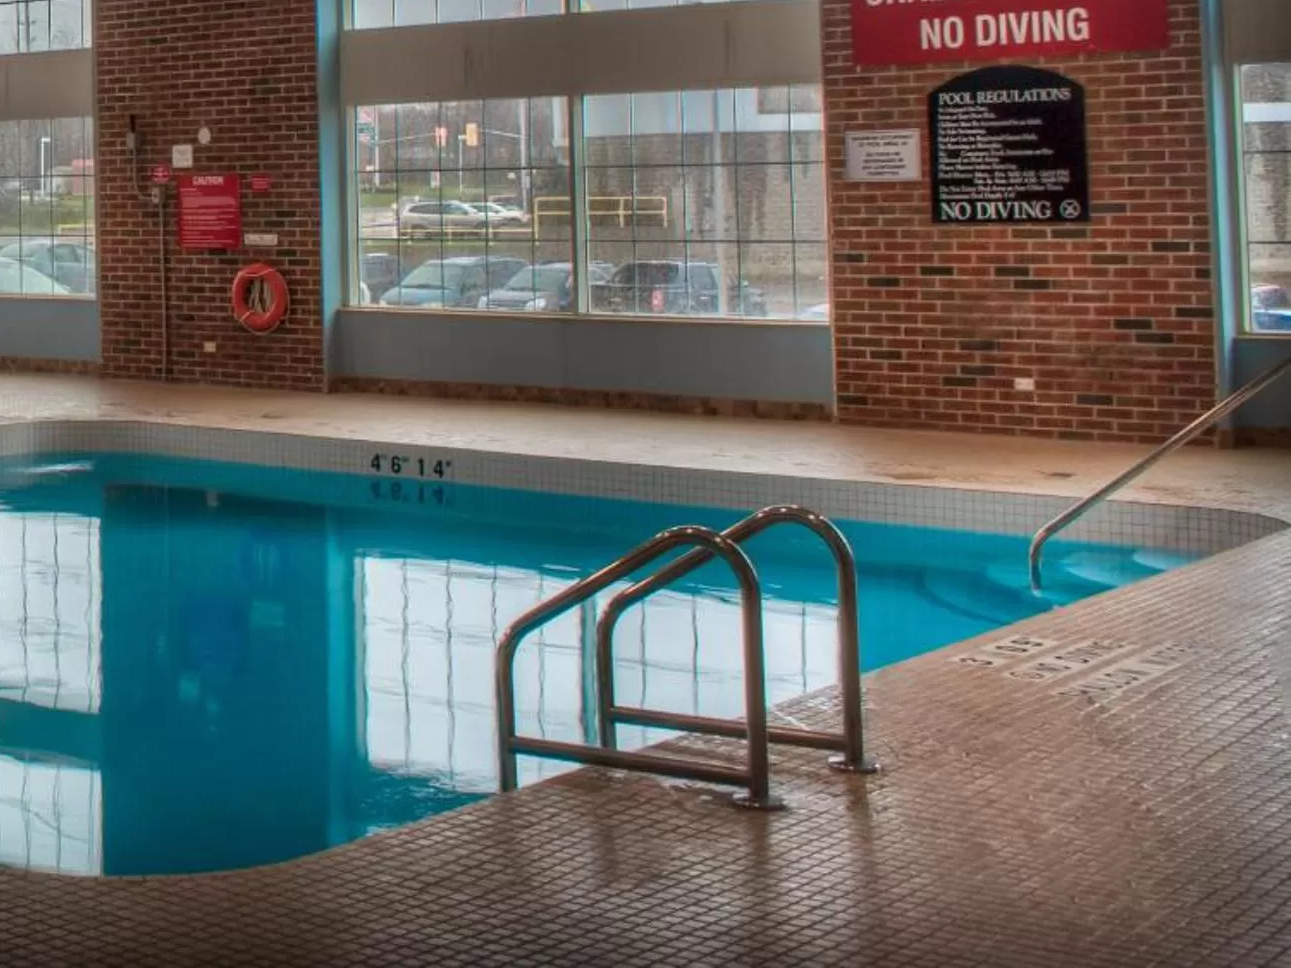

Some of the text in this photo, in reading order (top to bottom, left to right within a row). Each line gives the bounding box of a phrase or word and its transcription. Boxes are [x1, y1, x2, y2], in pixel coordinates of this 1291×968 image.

[920, 7, 1090, 50] NO DIVING
[938, 88, 1071, 105] POOL REGULATIONS
[940, 201, 1052, 220] NO DIVING
